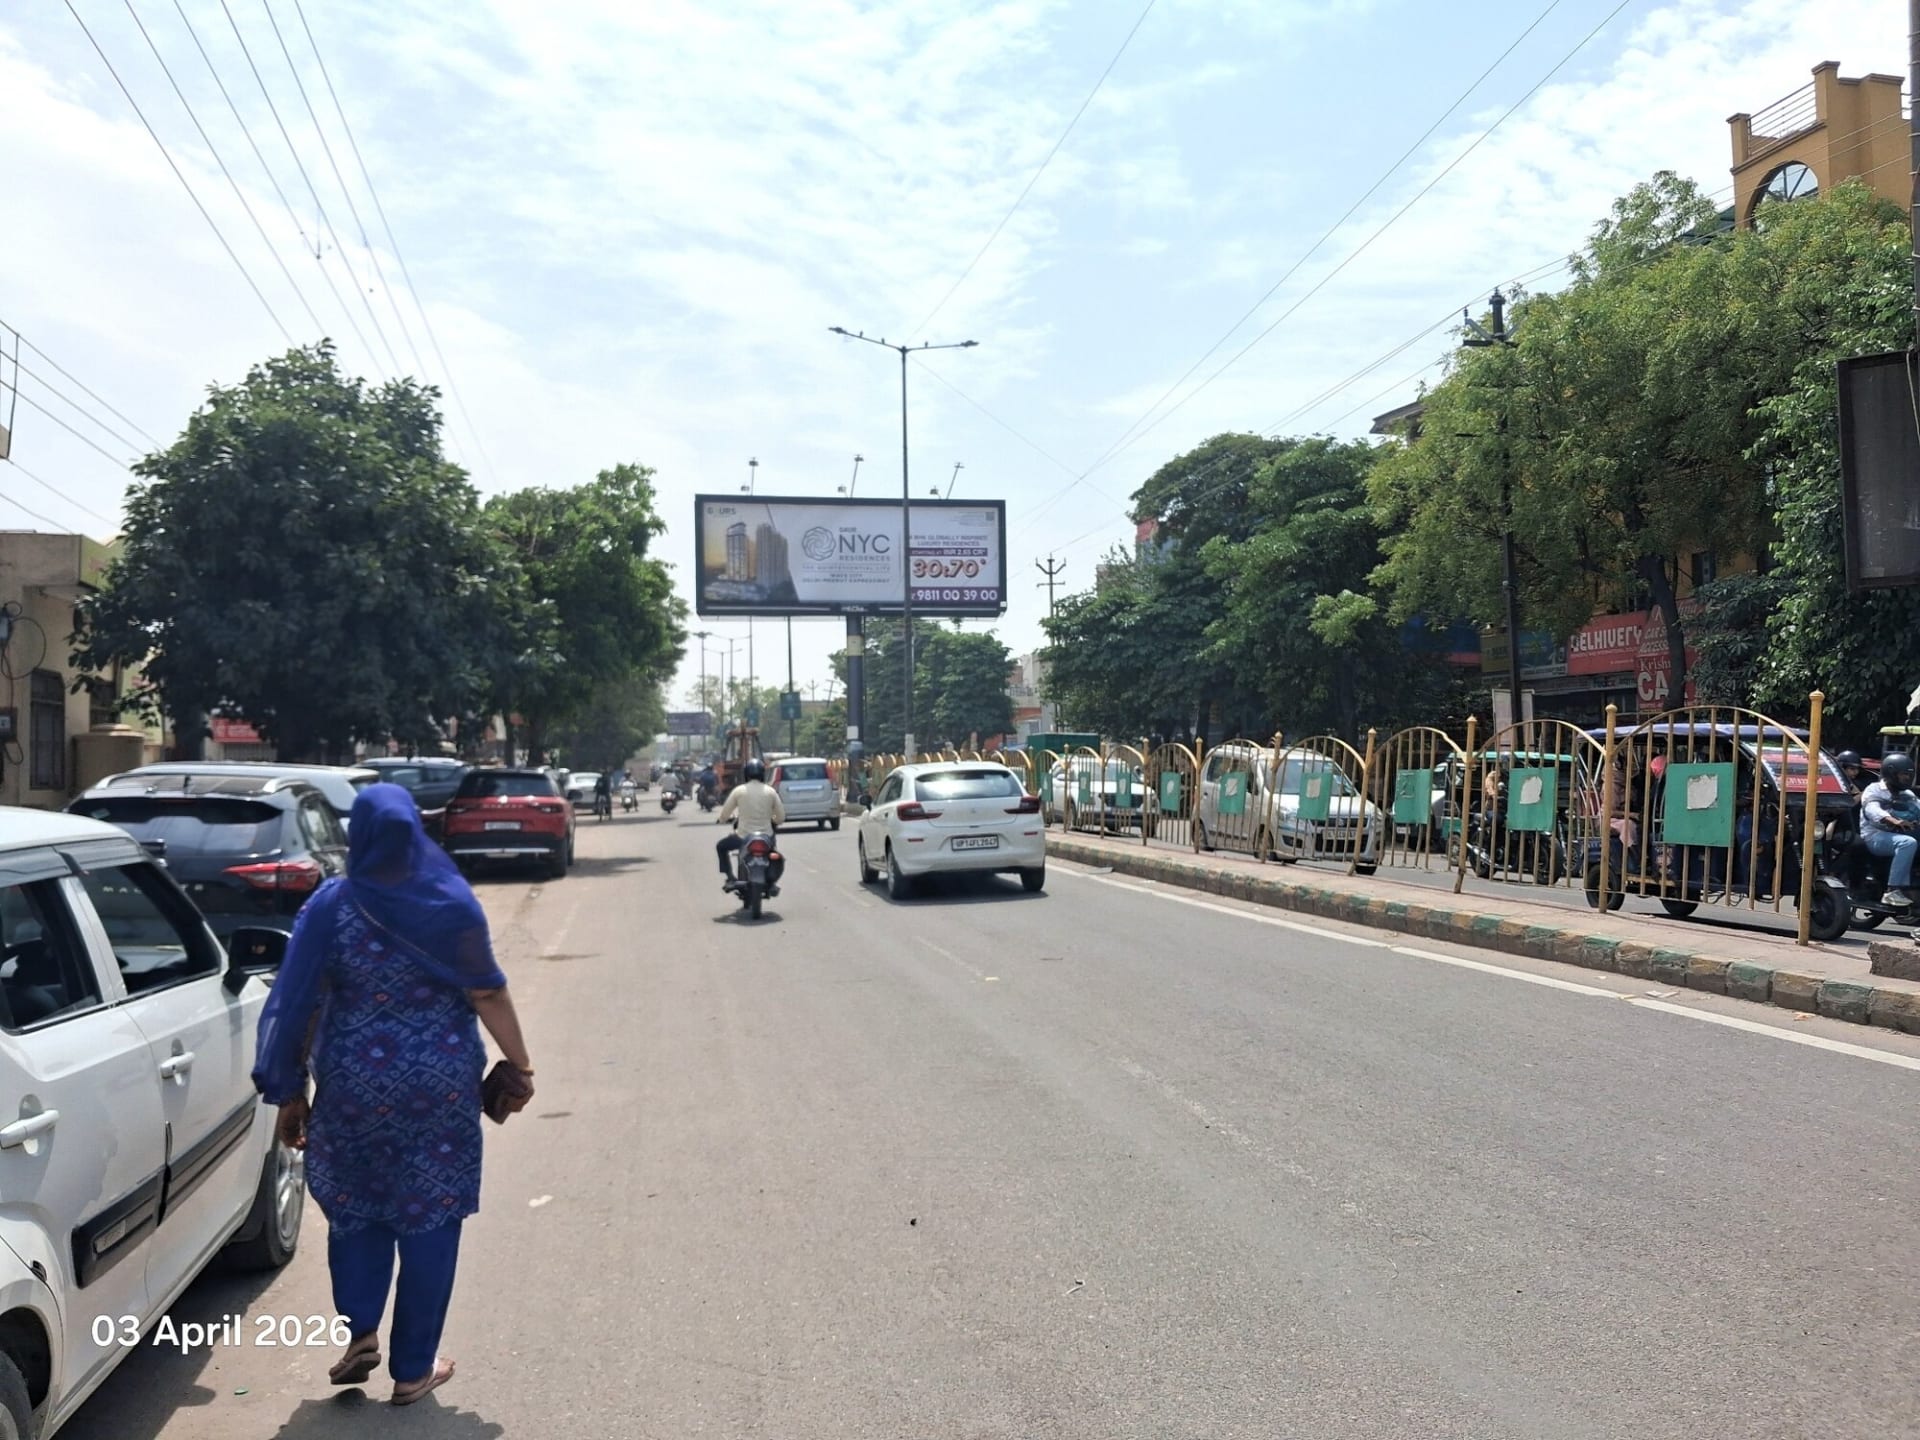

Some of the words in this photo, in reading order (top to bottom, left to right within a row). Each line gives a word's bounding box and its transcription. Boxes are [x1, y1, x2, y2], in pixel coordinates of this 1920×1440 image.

[839, 534, 890, 554] NYC
[917, 590, 940, 601] 9811
[943, 590, 960, 601] 00
[963, 590, 978, 601] 39
[981, 590, 998, 601] 00
